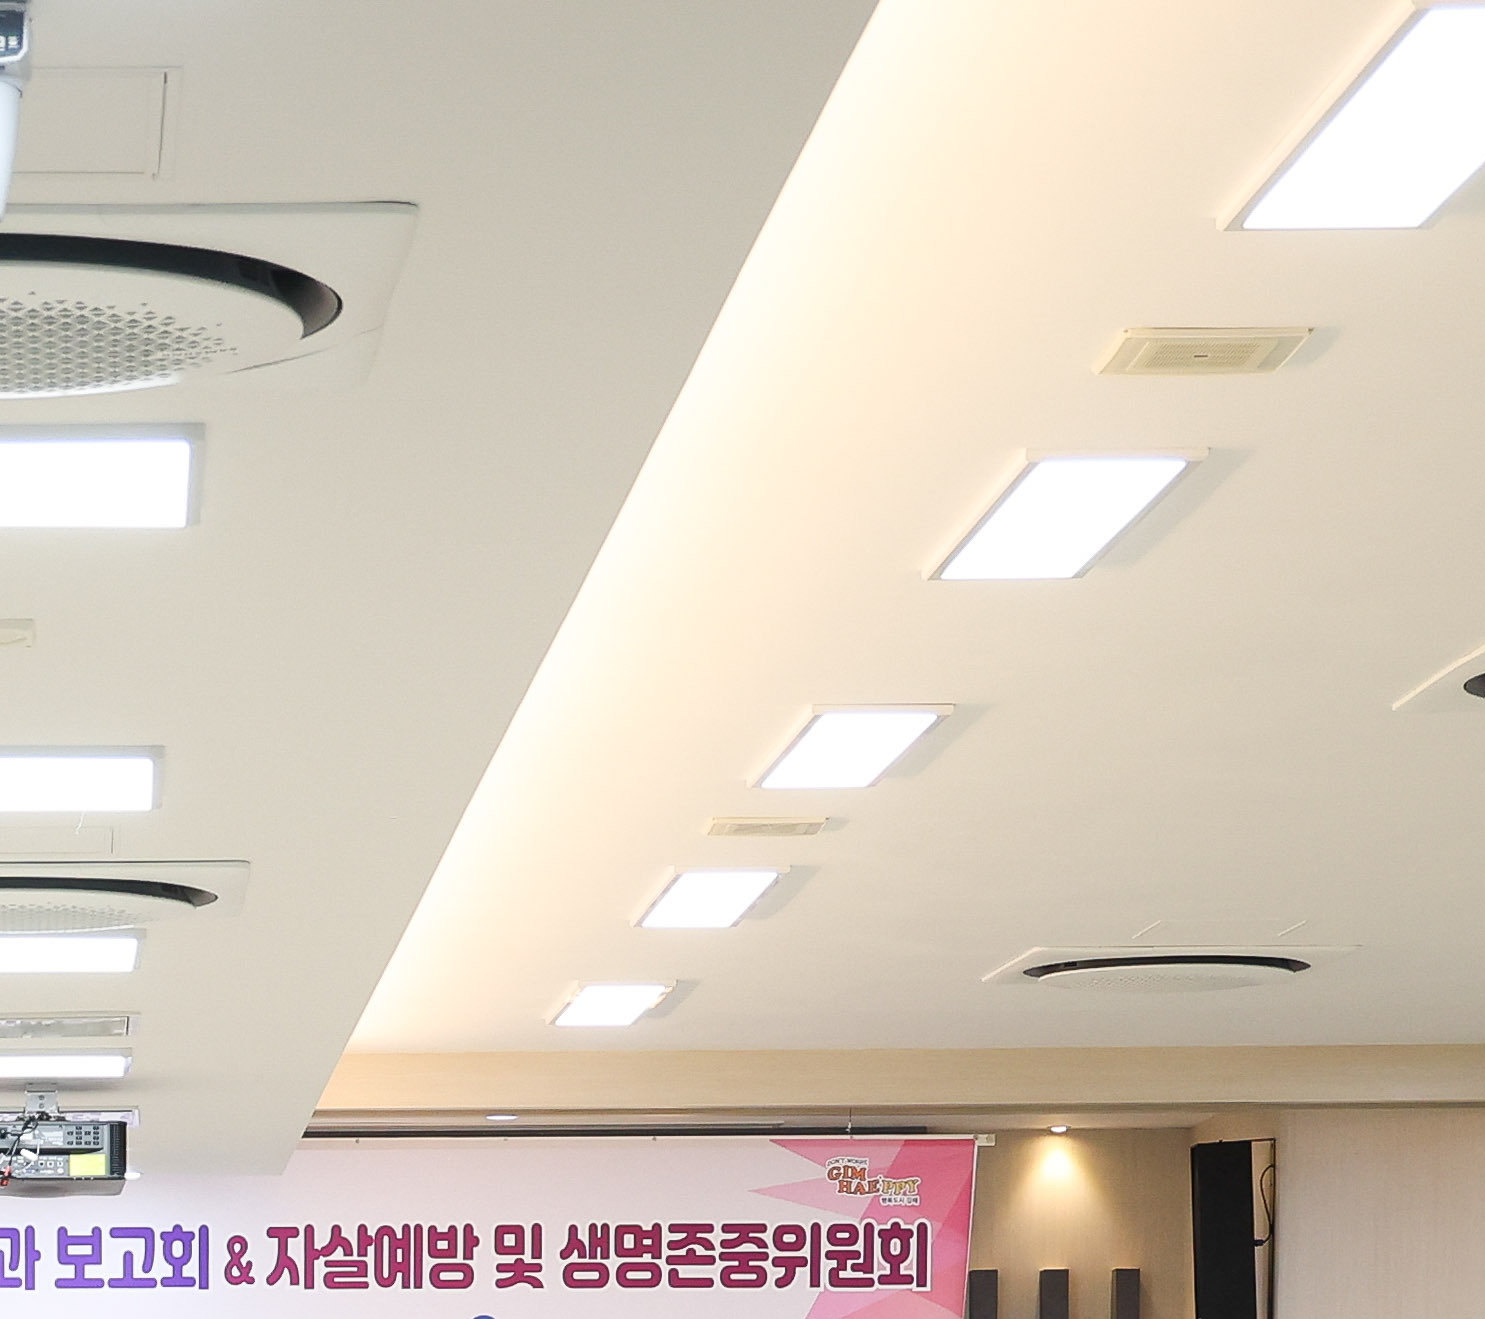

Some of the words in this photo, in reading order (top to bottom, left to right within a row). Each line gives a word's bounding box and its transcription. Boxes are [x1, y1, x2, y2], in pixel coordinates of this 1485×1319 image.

[827, 1165, 867, 1181] GIM
[56, 1224, 210, 1290] 보고회
[225, 1238, 253, 1286] &
[267, 1223, 480, 1290] 자살예방
[493, 1223, 545, 1290] 및
[559, 1221, 929, 1290] 생명존중위원회
